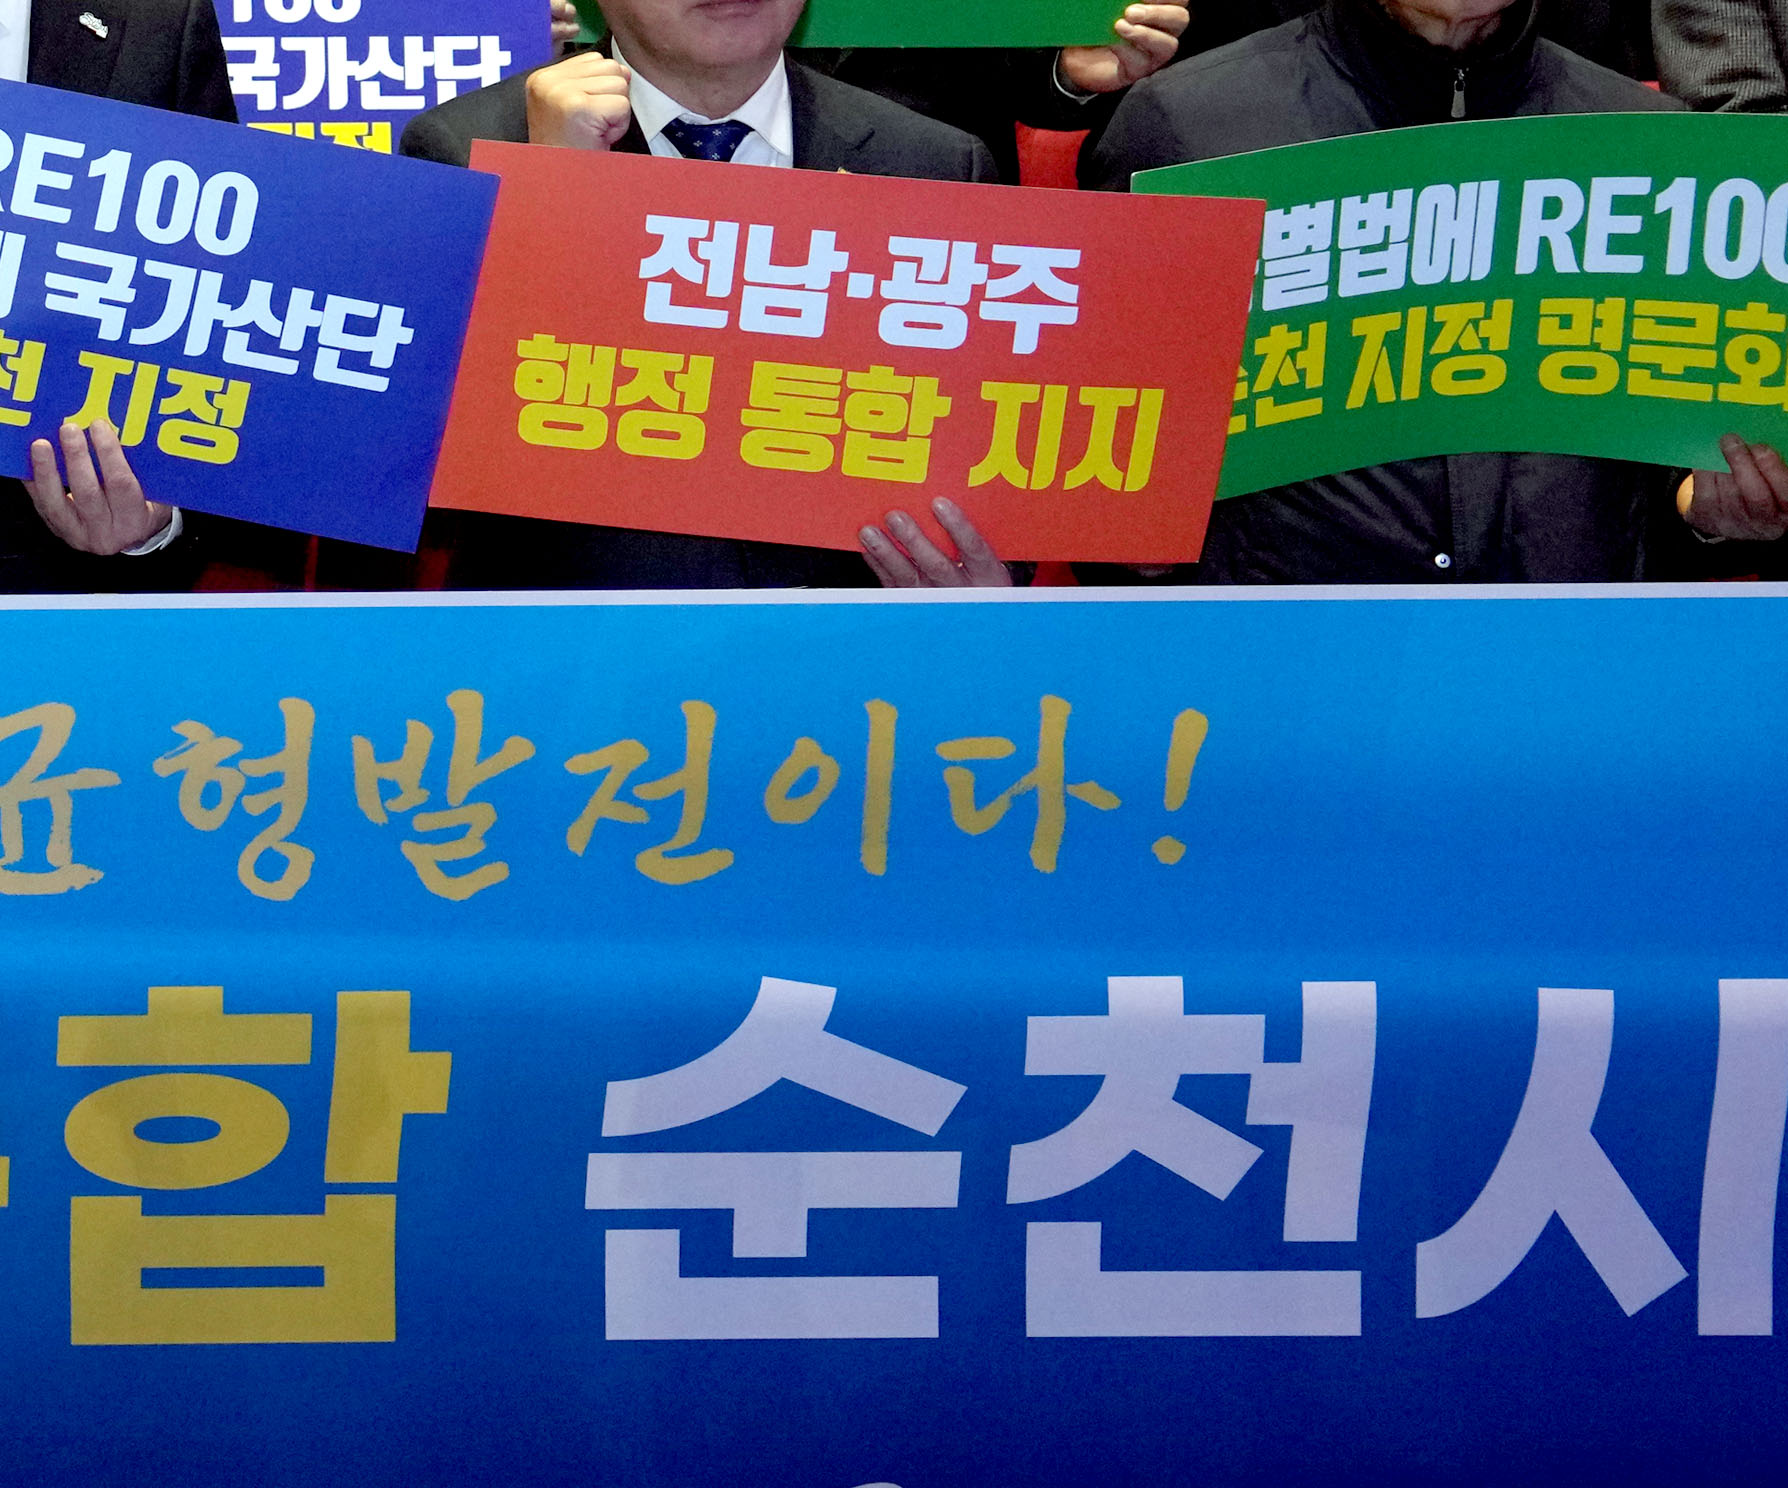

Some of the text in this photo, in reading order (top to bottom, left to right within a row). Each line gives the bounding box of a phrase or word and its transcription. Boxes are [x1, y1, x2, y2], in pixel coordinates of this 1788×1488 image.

[227, 34, 512, 113] 국가산단
[43, 240, 416, 391] 국가산단
[638, 213, 1084, 354] 전남·광주
[1247, 175, 1494, 316] 별법에
[72, 349, 252, 465] 지정
[514, 333, 1166, 493] 행정 통합 지지
[1346, 300, 1511, 408] 지정
[1538, 294, 1788, 414] 명문화
[584, 973, 1788, 1341] 순천시
